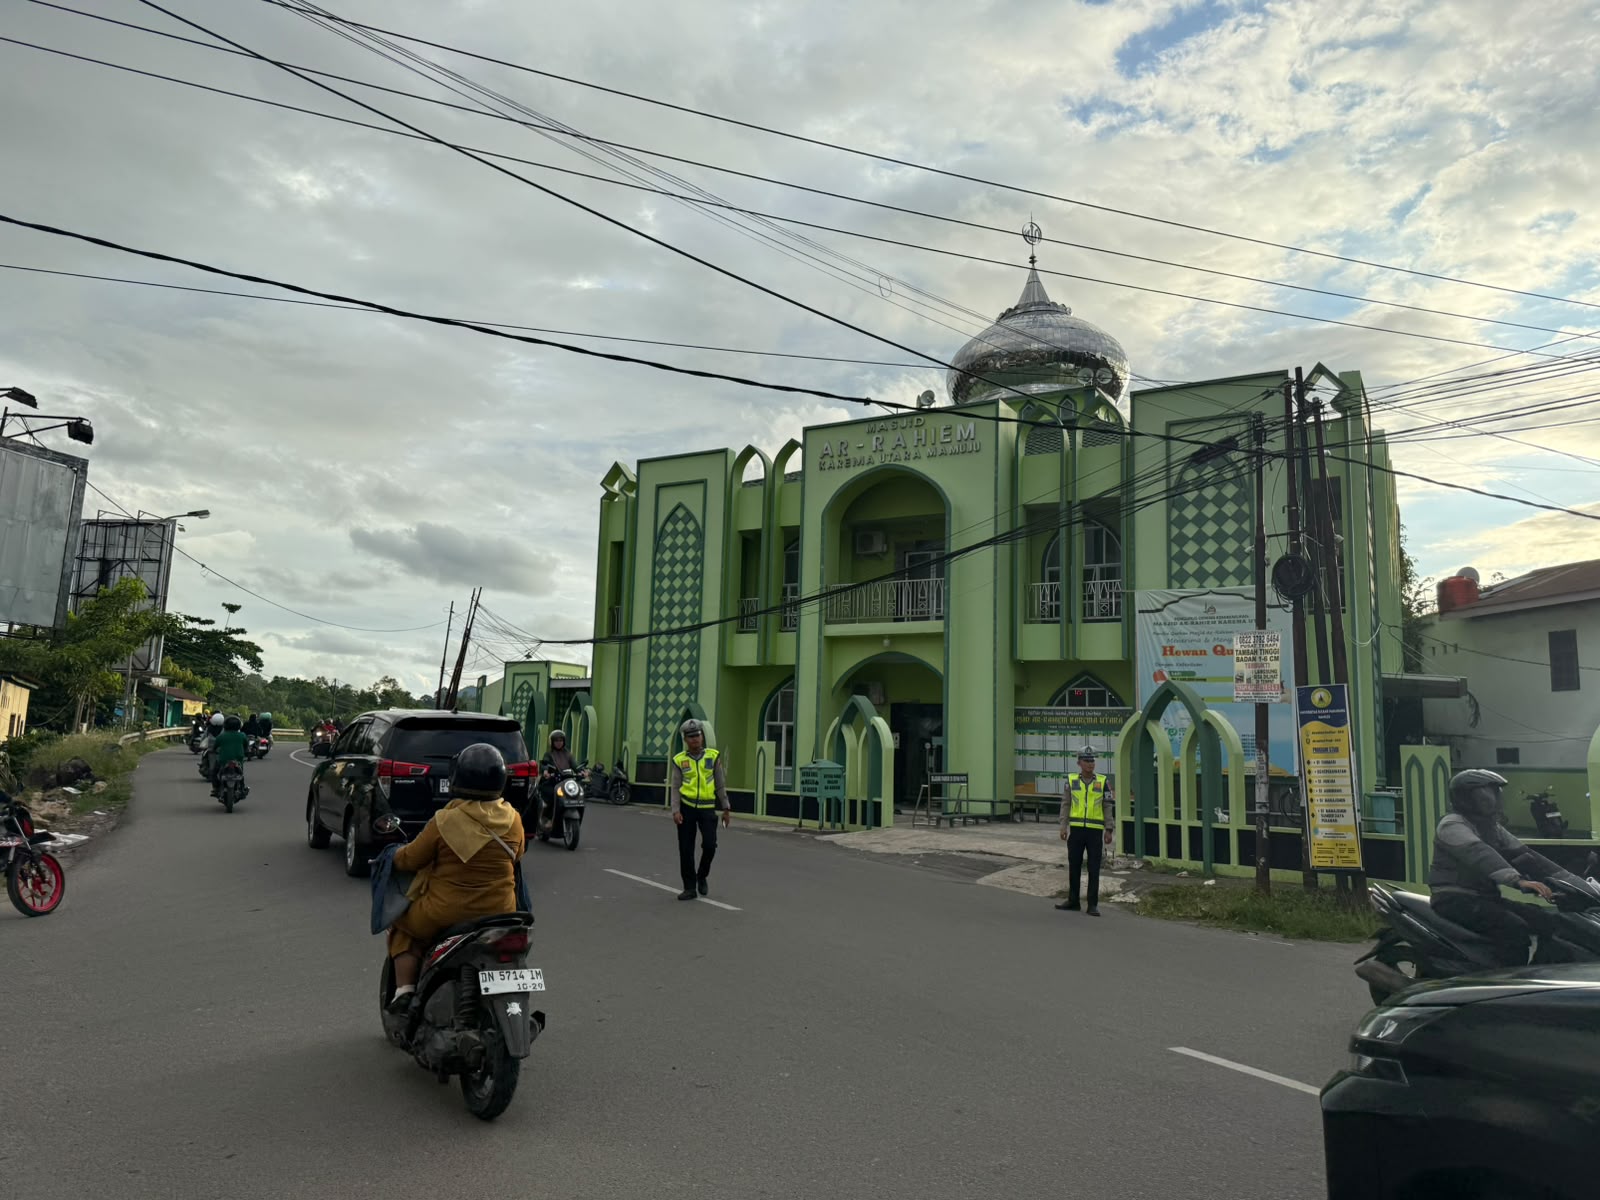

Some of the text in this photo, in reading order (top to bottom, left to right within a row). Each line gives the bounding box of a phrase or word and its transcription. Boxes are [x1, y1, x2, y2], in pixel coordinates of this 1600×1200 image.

[866, 417, 925, 434] MASJID
[820, 440, 849, 459] AR
[872, 422, 976, 452] RAHIEM
[819, 441, 981, 471] KAREMA UTARA MAMUJU
[1162, 646, 1208, 656] Hewan
[480, 972, 495, 983] DN
[499, 970, 525, 981] 5714
